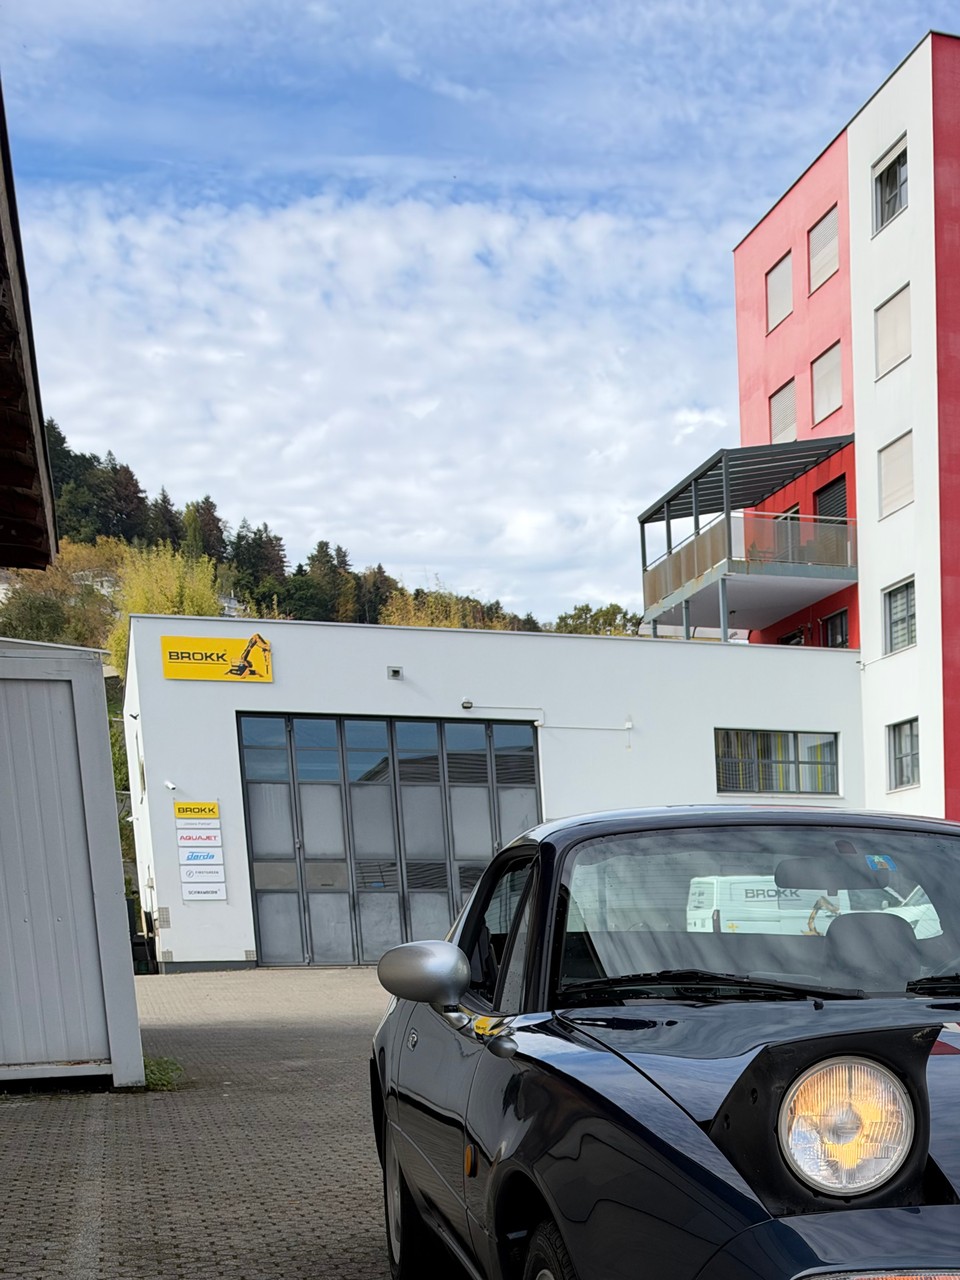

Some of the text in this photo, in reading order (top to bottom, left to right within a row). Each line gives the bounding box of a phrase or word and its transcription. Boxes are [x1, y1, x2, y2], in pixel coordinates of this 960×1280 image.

[168, 651, 228, 662] BROKK
[177, 806, 216, 814] BROKK
[186, 851, 215, 861] darda
[745, 889, 801, 899] BROKK
